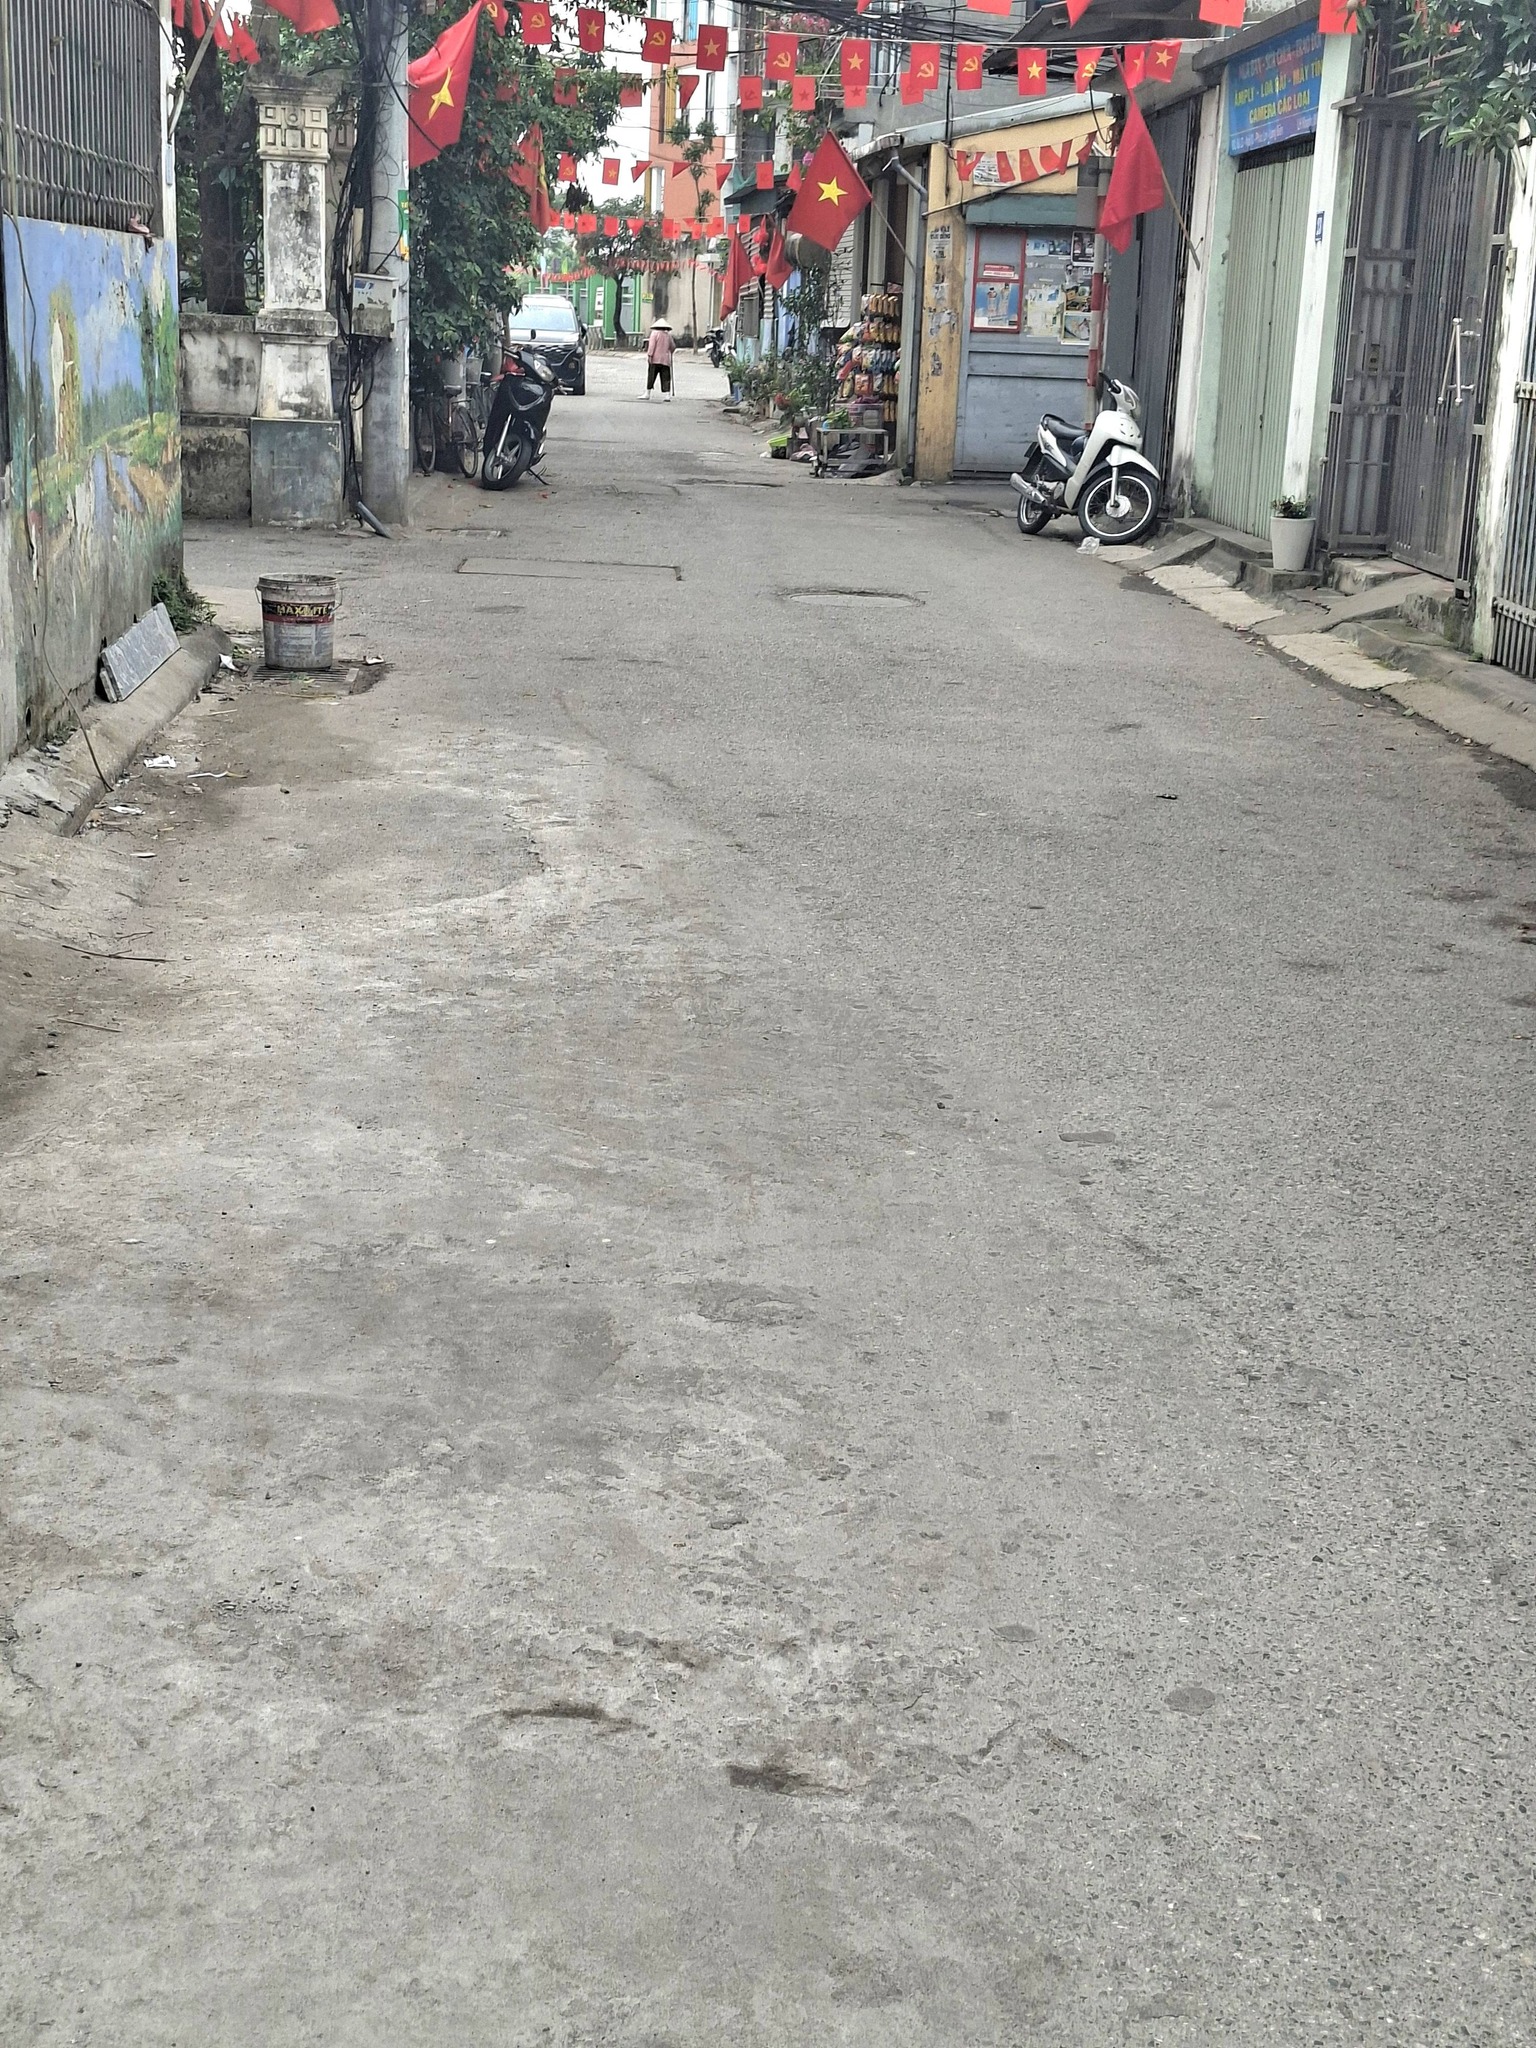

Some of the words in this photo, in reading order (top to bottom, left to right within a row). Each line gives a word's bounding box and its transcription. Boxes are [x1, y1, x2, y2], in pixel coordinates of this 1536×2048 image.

[1261, 79, 1274, 98] LOA
[1249, 102, 1277, 125] CAMERA
[1277, 94, 1292, 115] CÁC
[1292, 88, 1310, 110] LOẠI
